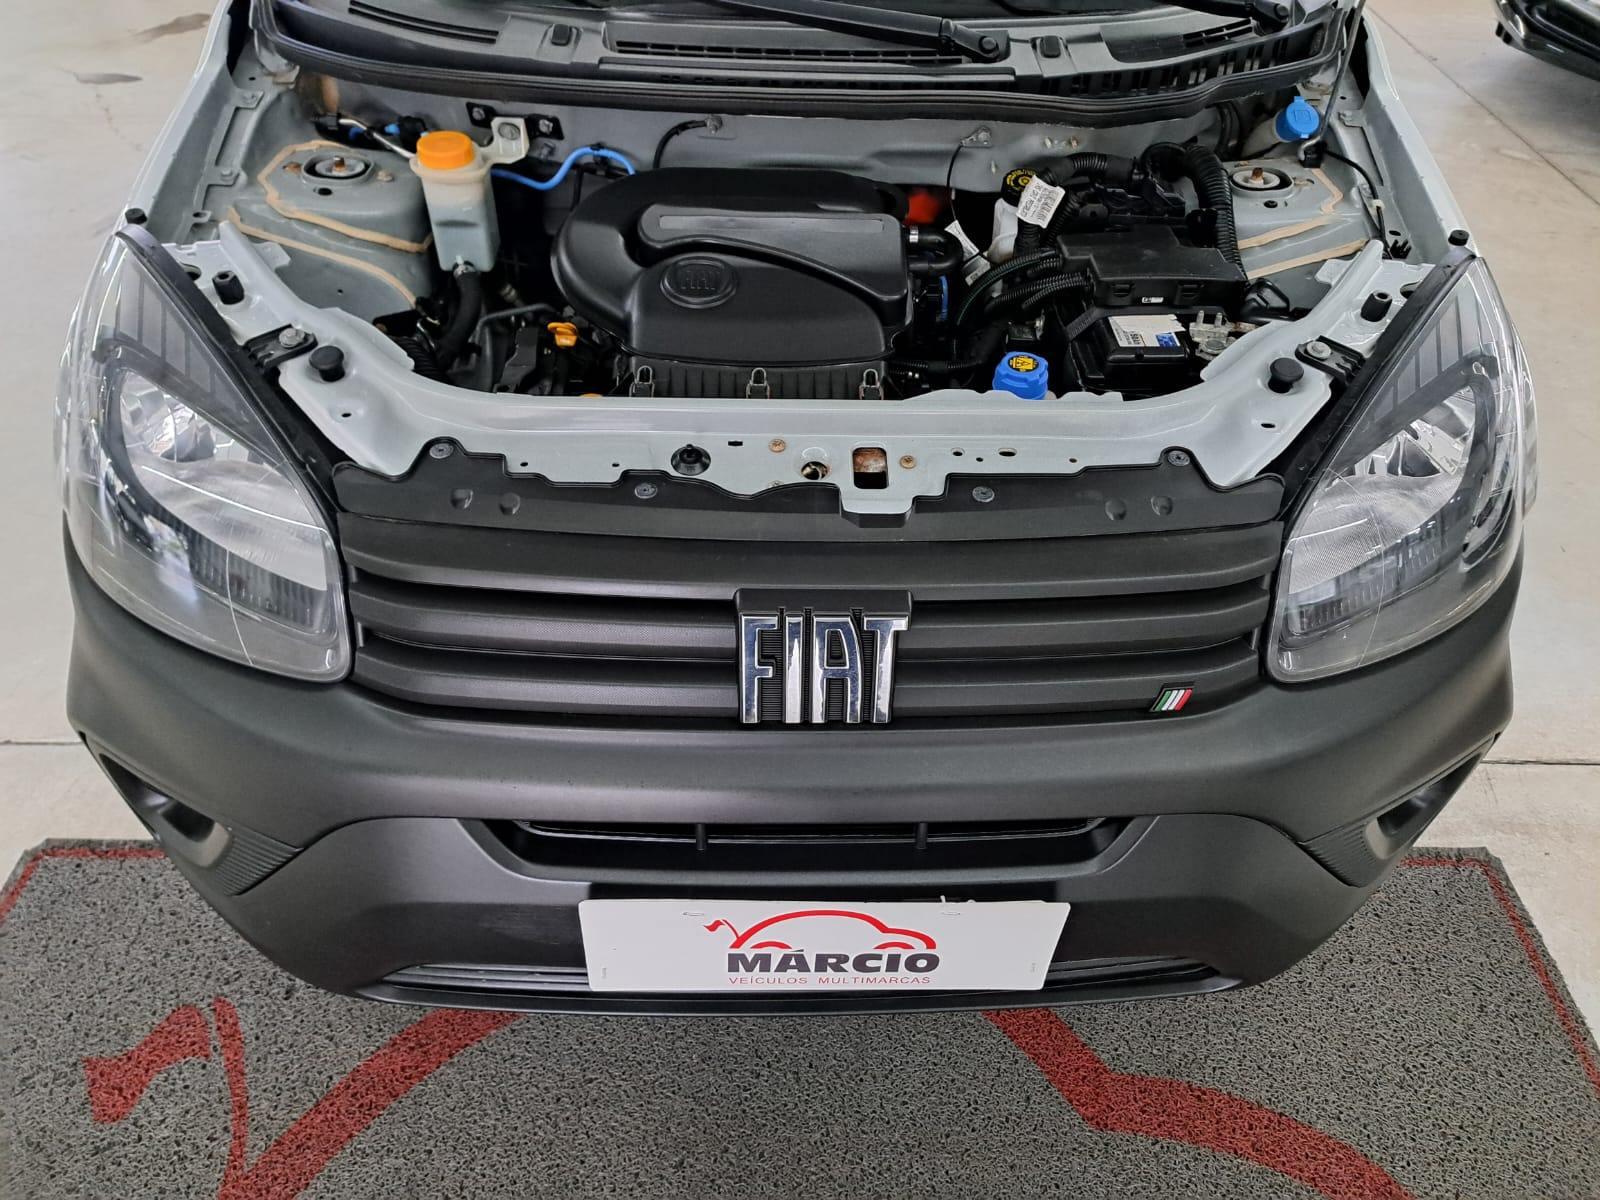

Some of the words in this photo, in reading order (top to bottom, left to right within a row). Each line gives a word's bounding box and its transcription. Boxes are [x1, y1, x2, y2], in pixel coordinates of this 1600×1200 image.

[741, 615, 909, 724] FIAT
[727, 949, 940, 973] MÁRCIO
[729, 976, 808, 985] VEÍCULOS
[818, 976, 931, 985] MULTIMARCAS
